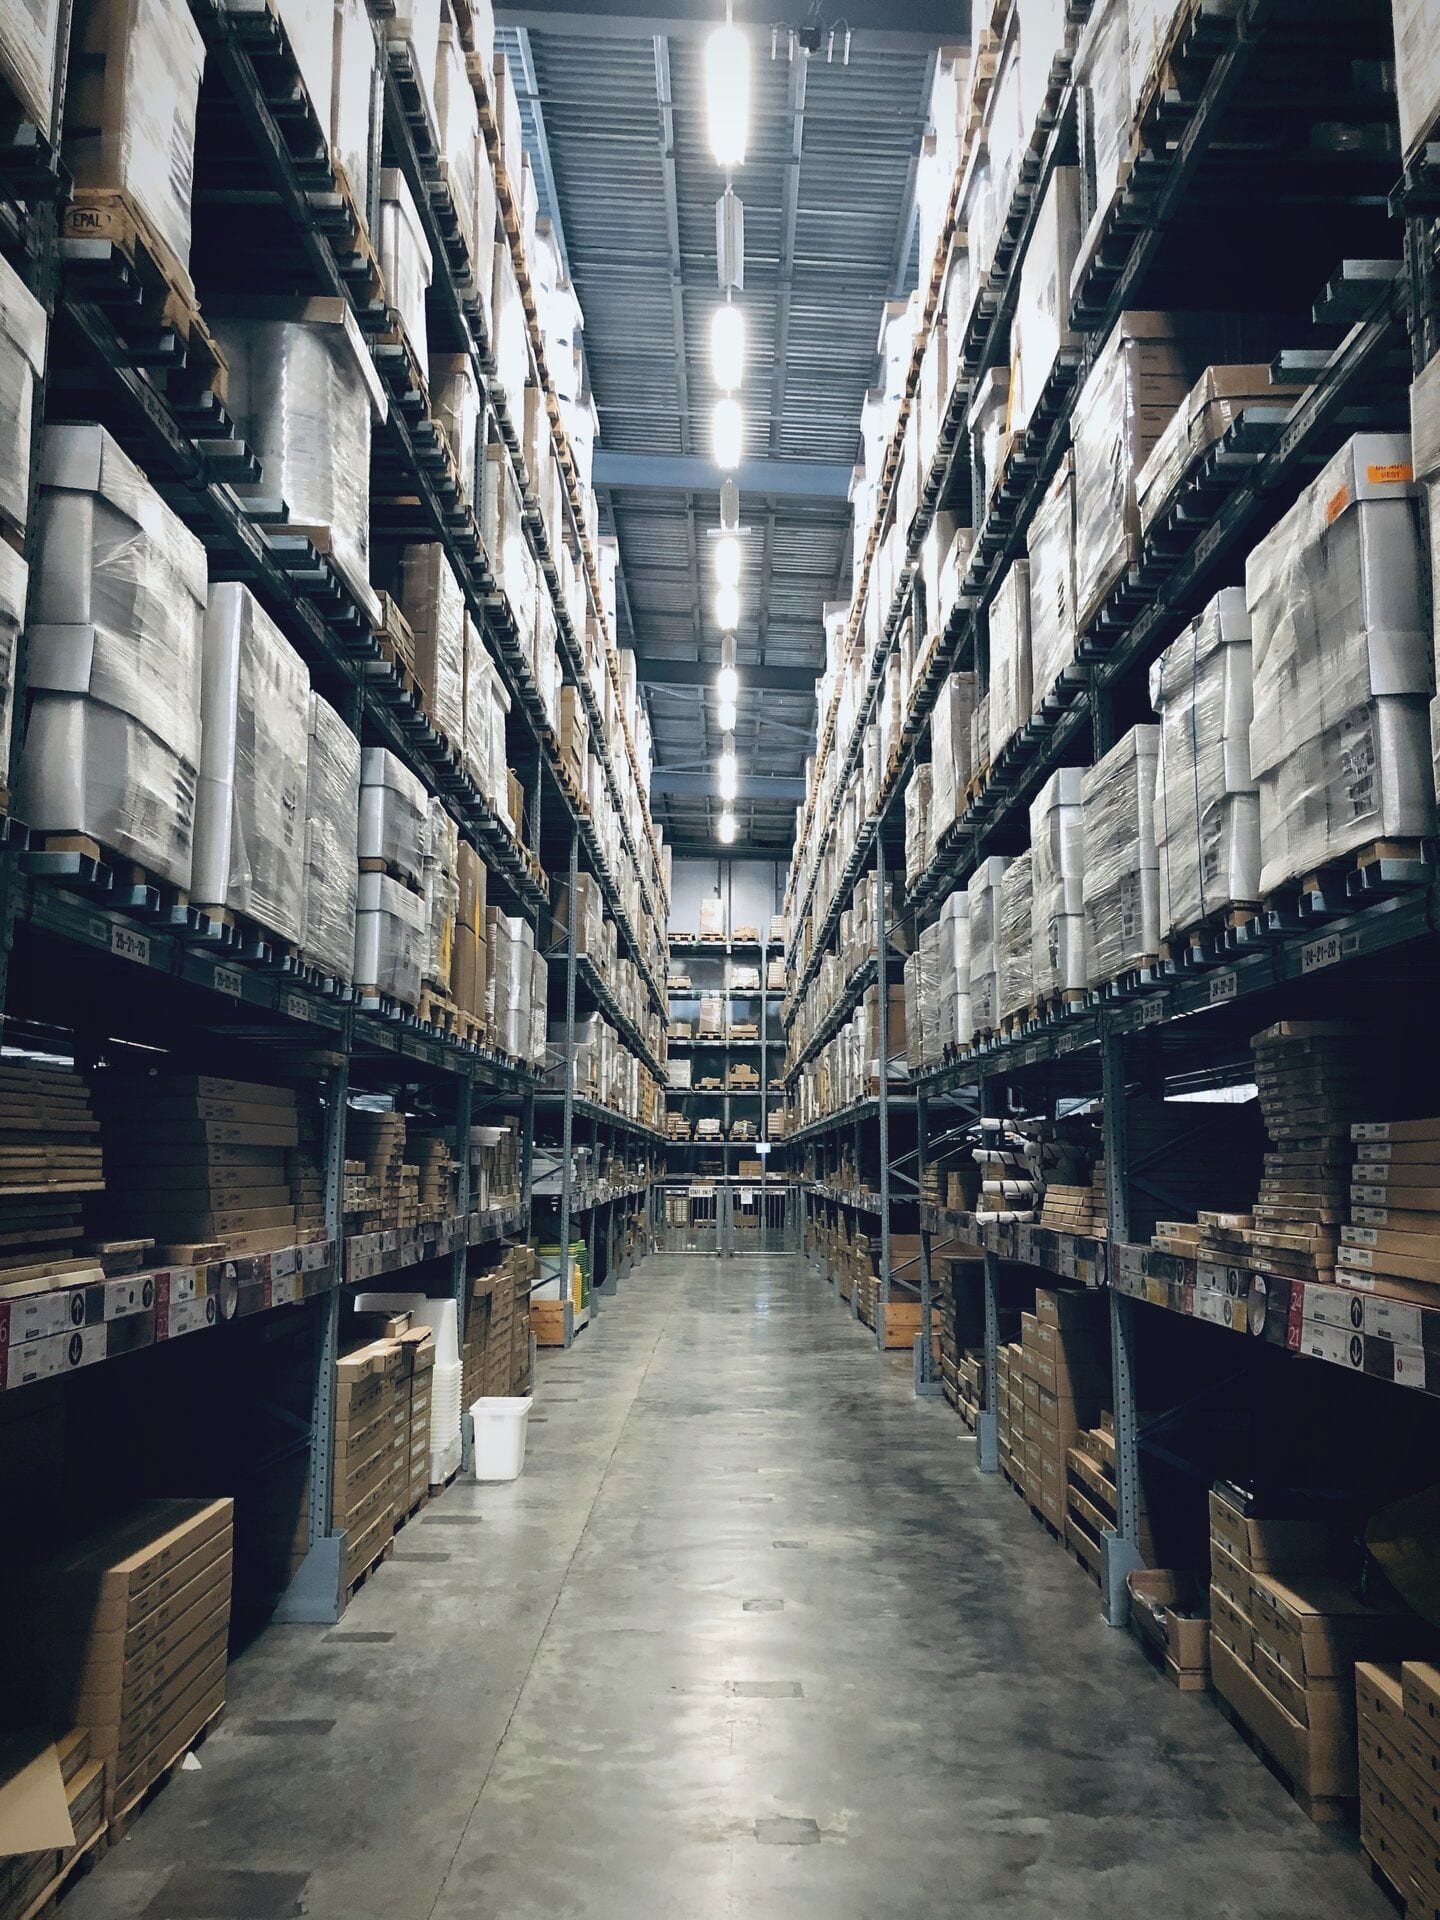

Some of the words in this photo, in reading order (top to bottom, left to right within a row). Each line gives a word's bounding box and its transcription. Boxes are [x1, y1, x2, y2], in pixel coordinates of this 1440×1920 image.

[72, 212, 104, 228] EPAL
[1305, 939, 1337, 967] 24-21-20
[1290, 1292, 1302, 1311] 24
[1288, 1326, 1300, 1347] 21
